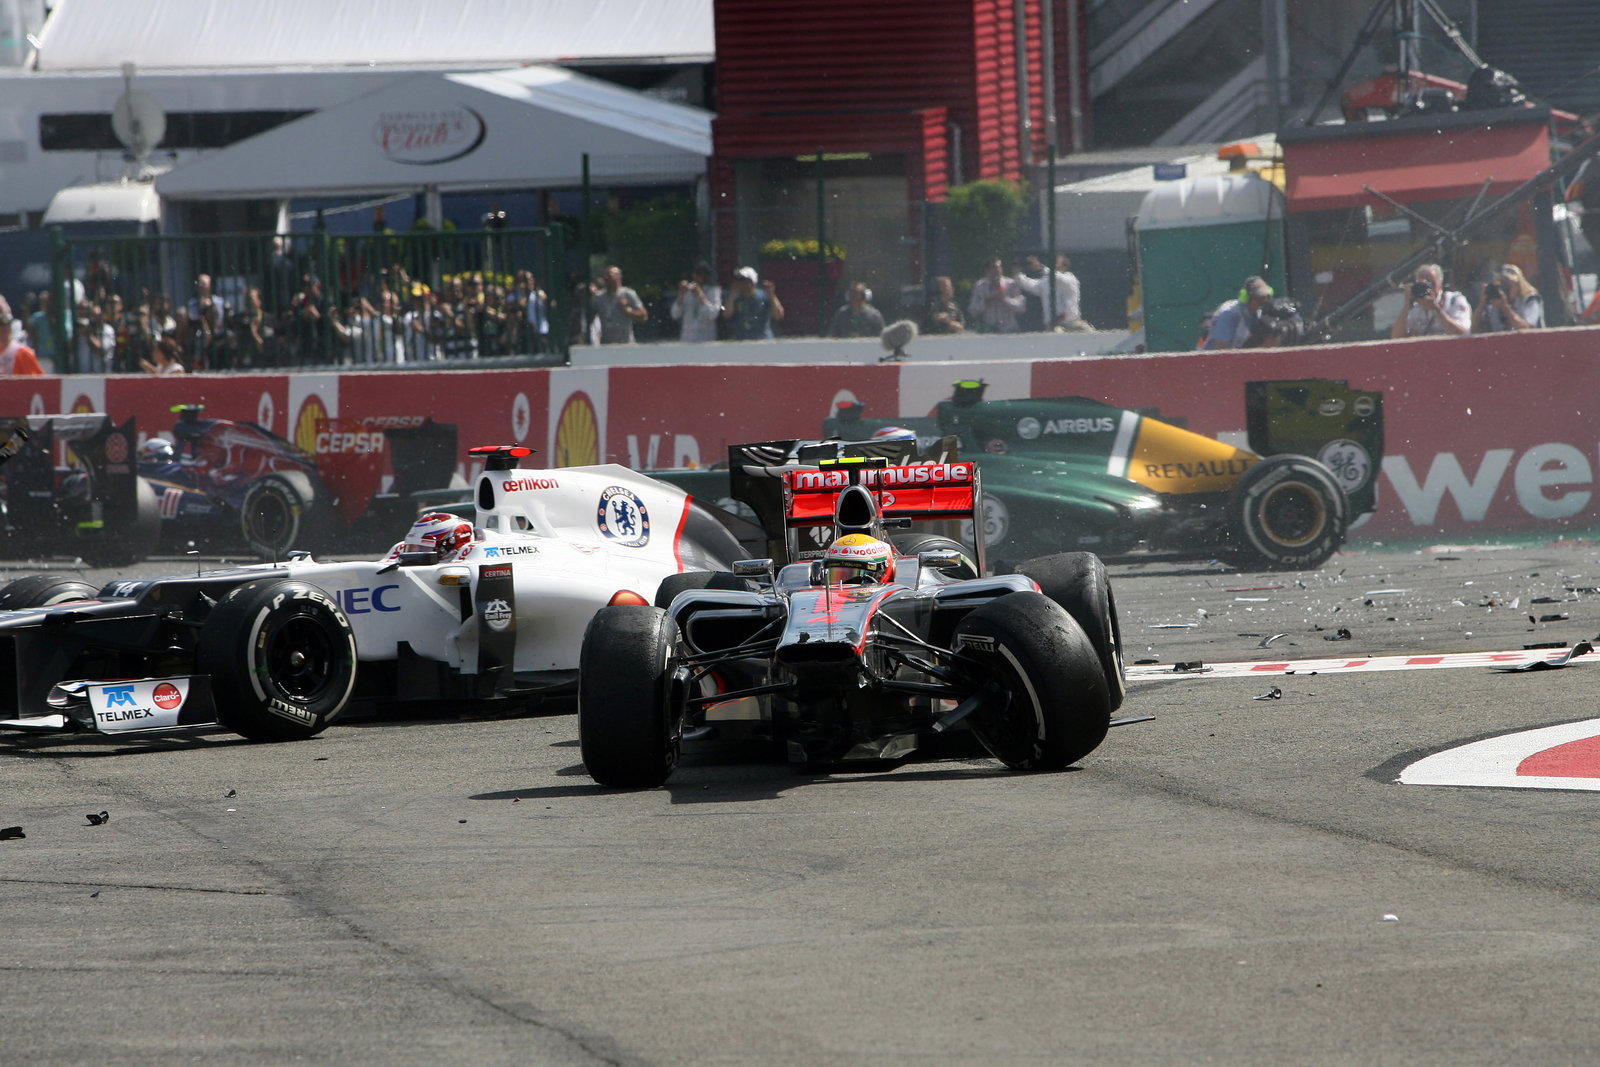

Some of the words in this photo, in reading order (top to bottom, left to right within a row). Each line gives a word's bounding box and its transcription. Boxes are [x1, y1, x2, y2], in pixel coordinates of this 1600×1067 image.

[1043, 417, 1114, 434] AIRBUS
[316, 432, 384, 453] CEPSA
[1145, 458, 1250, 479] RENAULT
[602, 487, 635, 501] CHELSEA
[500, 546, 540, 556] TELMEX
[485, 569, 511, 578] CERTINA
[112, 581, 143, 598] 14
[292, 589, 349, 628] ZERO
[154, 692, 178, 703] Claro
[97, 708, 154, 722] TELMEX
[267, 698, 317, 728] PIRELLI
